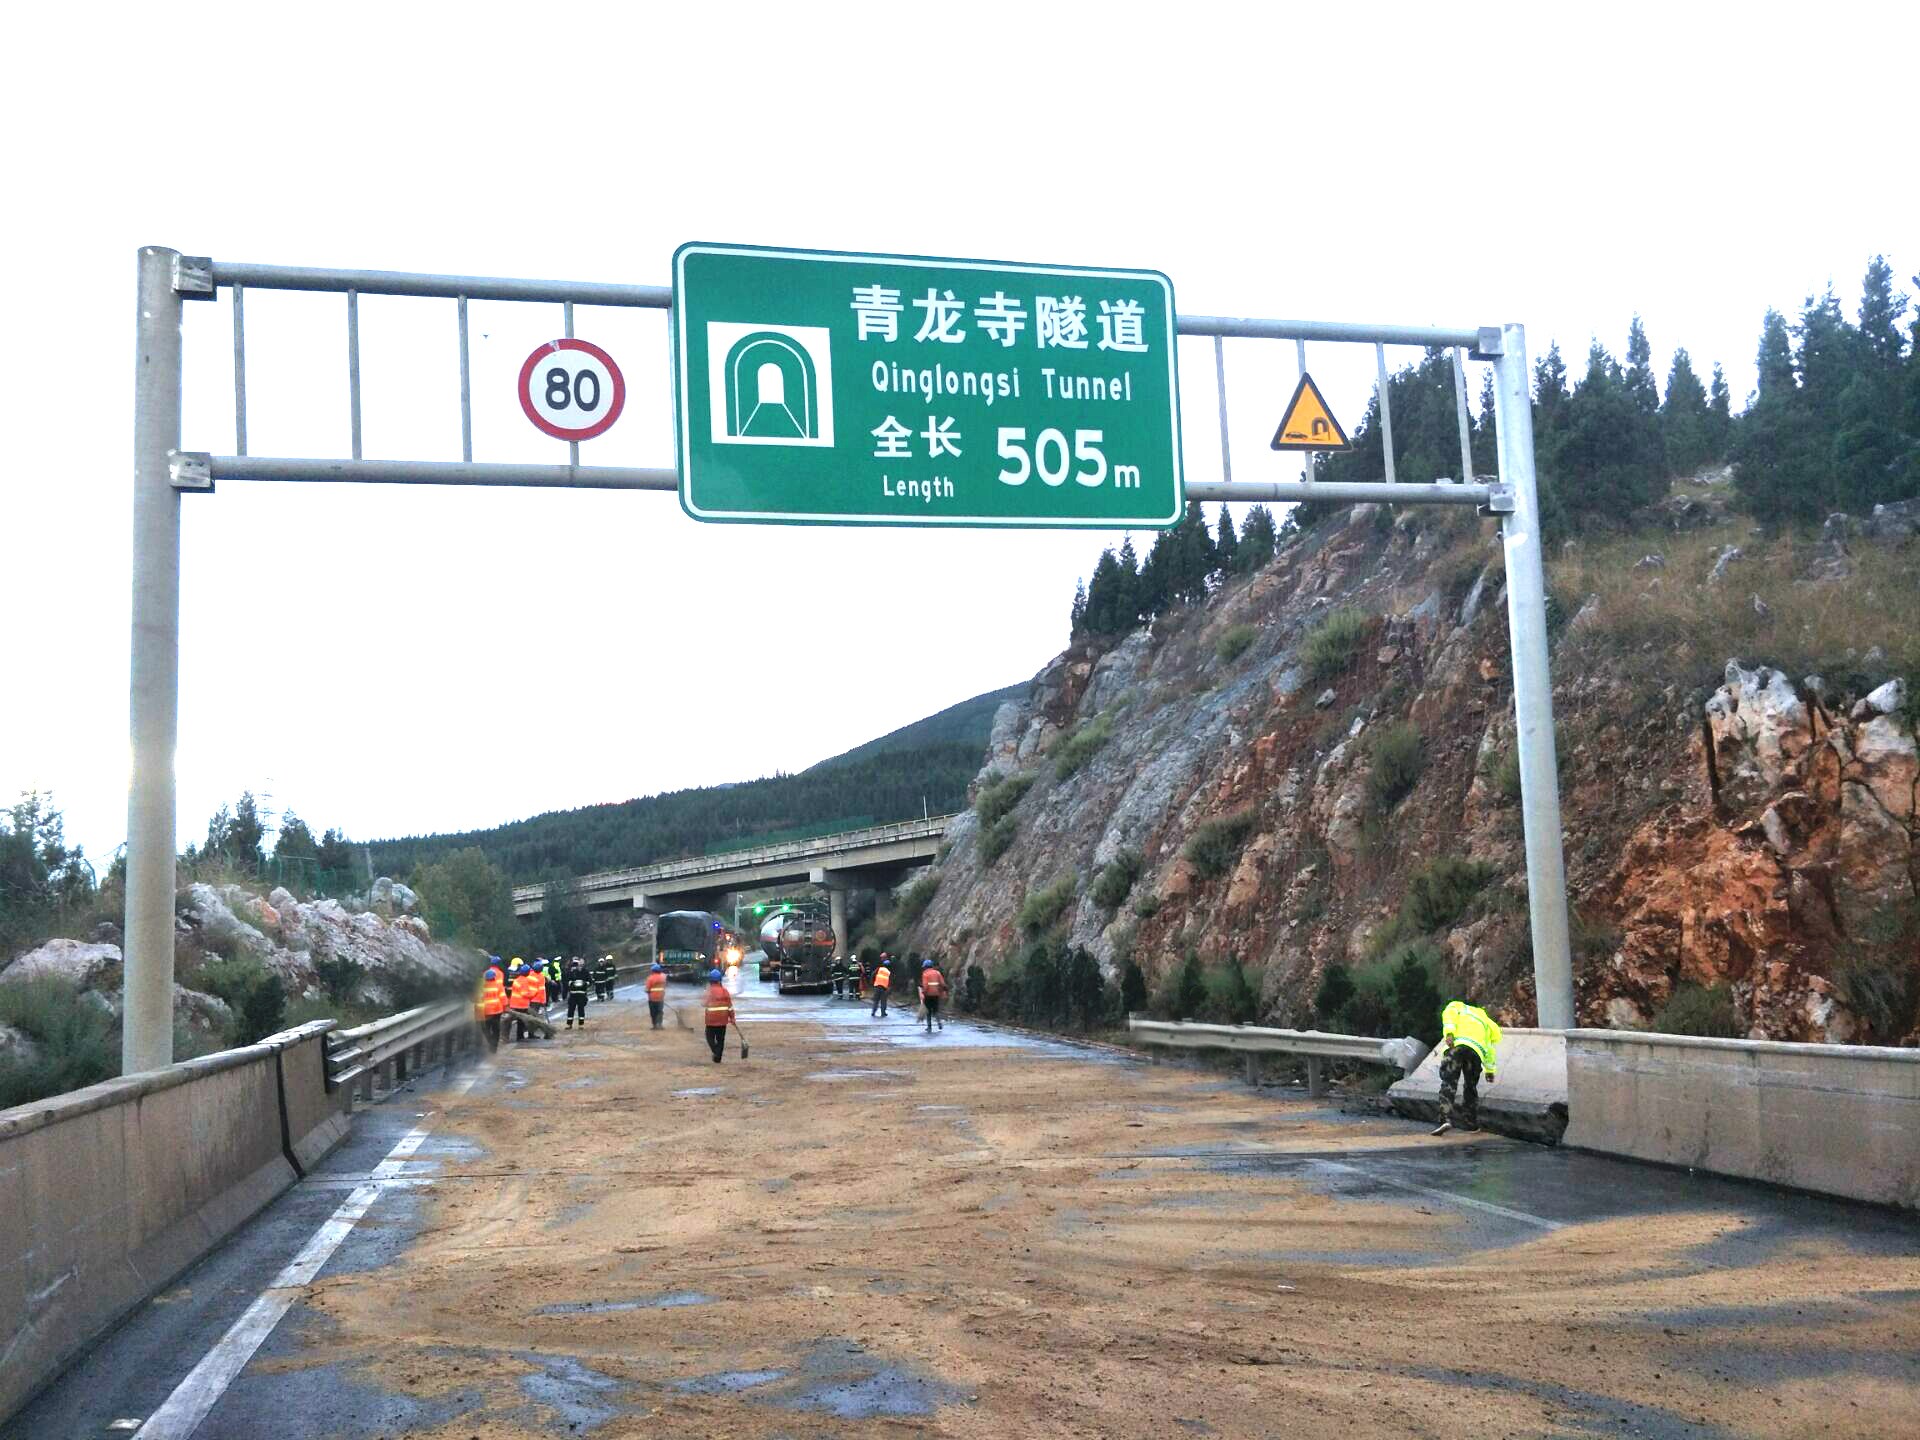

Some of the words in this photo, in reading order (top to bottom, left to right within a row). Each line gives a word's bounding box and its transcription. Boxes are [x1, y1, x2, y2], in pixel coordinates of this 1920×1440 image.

[850, 284, 1149, 352] 青龙寺隧道
[546, 367, 600, 411] 80
[871, 360, 1020, 406] Qinglongsi
[1041, 368, 1131, 401] Tunnel
[870, 415, 963, 458] 全长
[883, 474, 954, 504] Length
